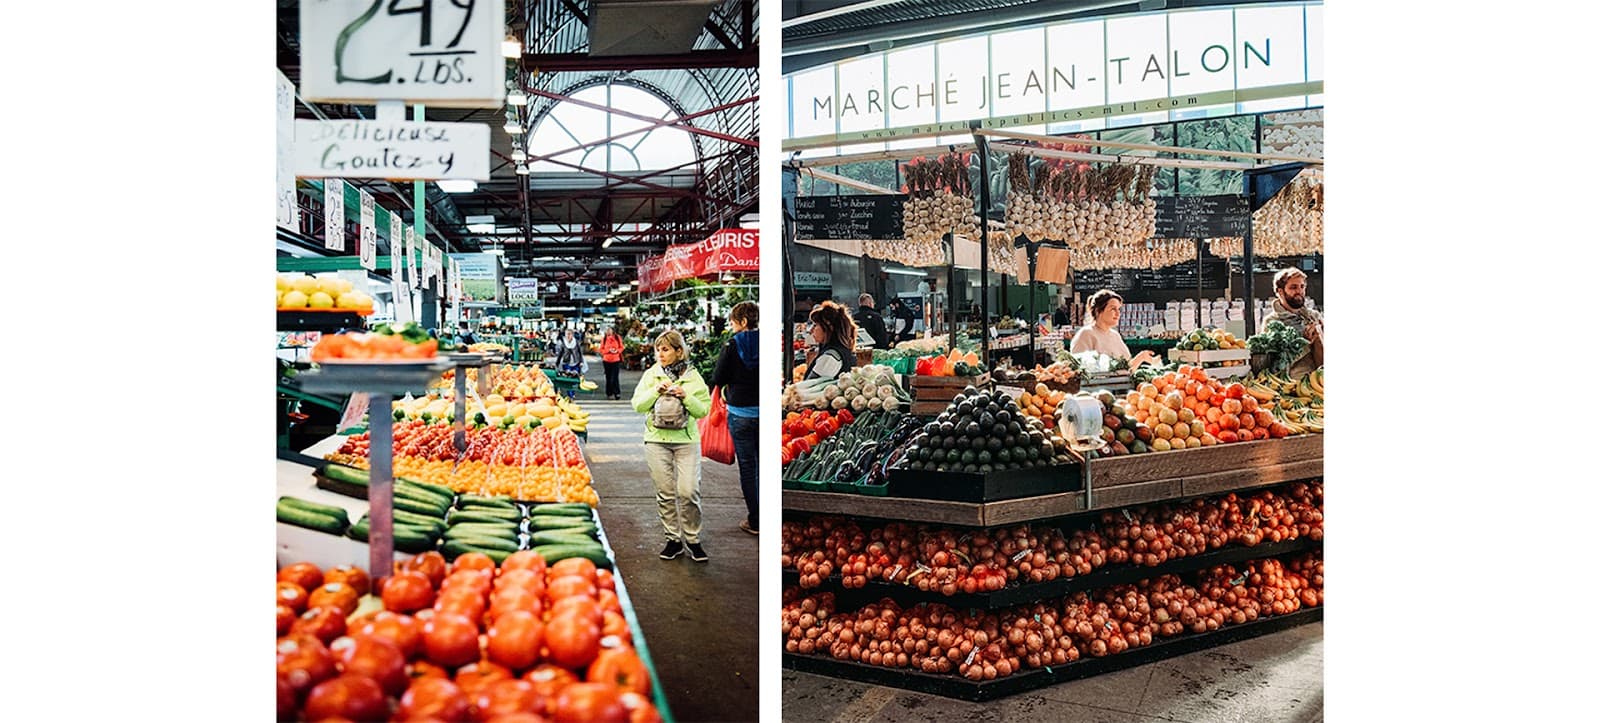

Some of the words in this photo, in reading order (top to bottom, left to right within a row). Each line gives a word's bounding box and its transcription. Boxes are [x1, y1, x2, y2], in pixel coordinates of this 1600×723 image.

[813, 73, 959, 121] MARCHÉ
[978, 38, 1271, 110] JEAN-TALON
[861, 96, 1198, 139] www.marchspublics-mtl.com
